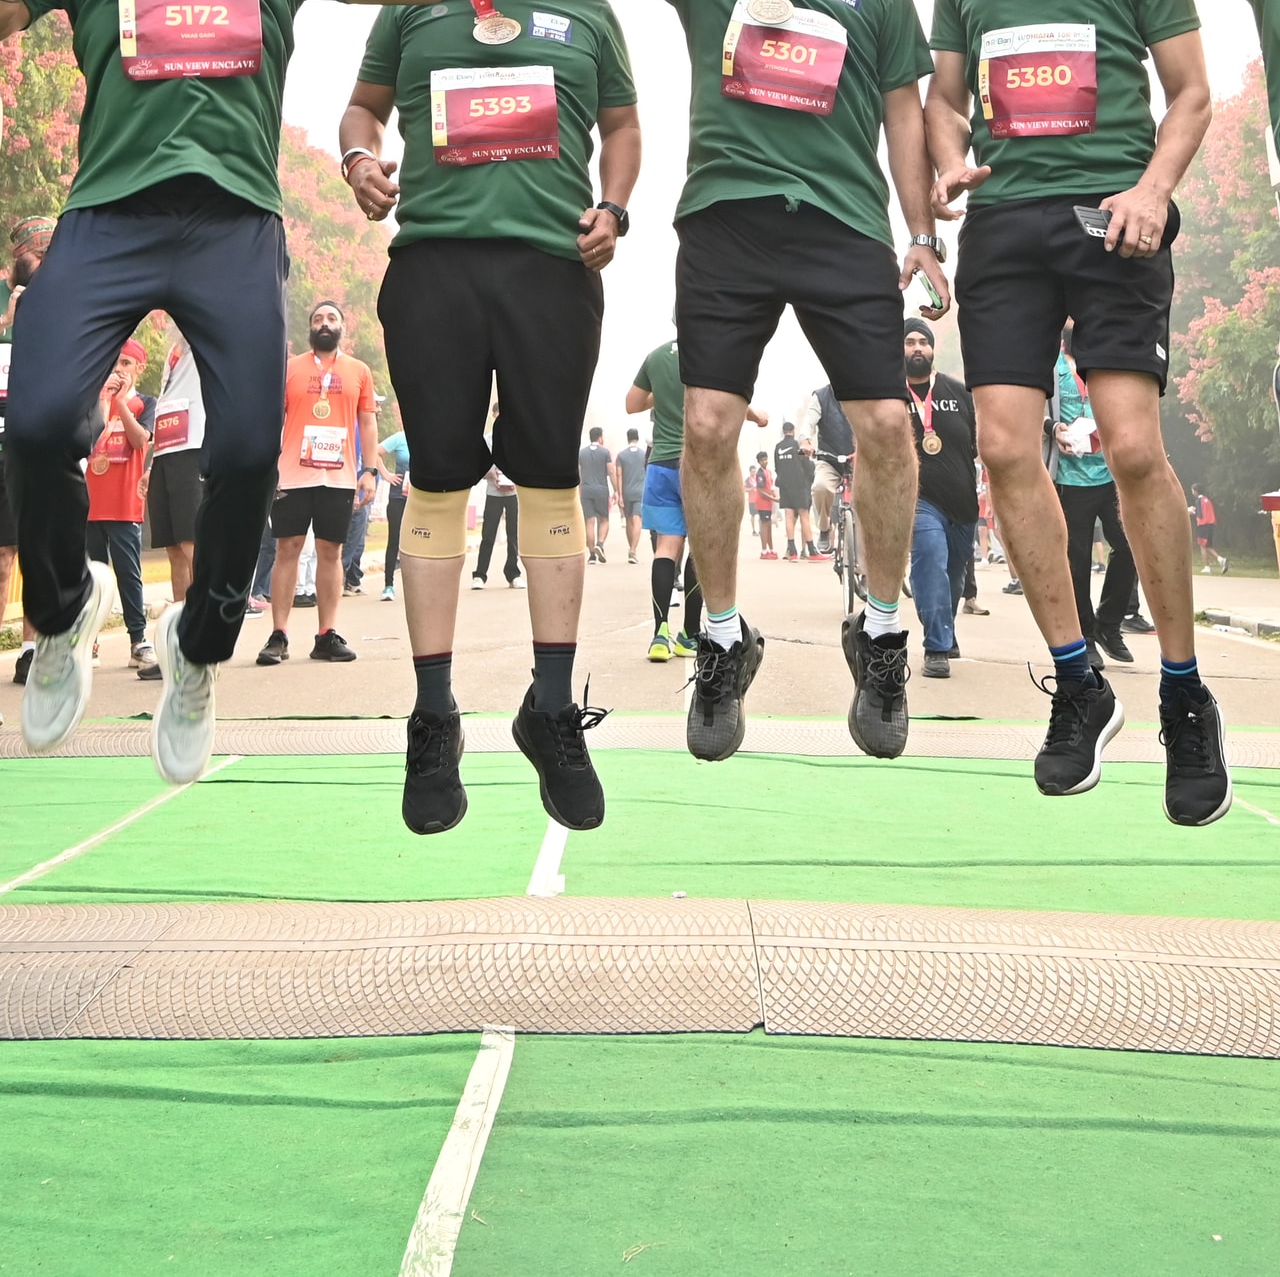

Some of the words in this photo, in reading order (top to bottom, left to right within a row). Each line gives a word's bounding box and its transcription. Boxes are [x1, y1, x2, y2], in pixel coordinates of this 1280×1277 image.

[165, 5, 230, 26] 5172
[760, 40, 818, 66] 5301
[164, 62, 184, 71] SUN
[185, 61, 210, 70] VIEW
[212, 60, 255, 69] ENCLAVE
[1006, 65, 1072, 89] 5380
[749, 88, 766, 96] SUN
[767, 91, 789, 101] VIEW
[789, 95, 828, 109] ENCLAVE
[469, 96, 532, 117] 5393
[1010, 122, 1025, 130] SUN
[1027, 121, 1049, 129] VIEW
[1051, 120, 1090, 128] ENCLAVE
[472, 150, 489, 158] SUN
[490, 149, 513, 157] VIEW
[514, 145, 553, 154] ENCLAVE
[158, 416, 179, 430] 5376
[108, 435, 124, 445] 413
[313, 442, 340, 452] 10289
